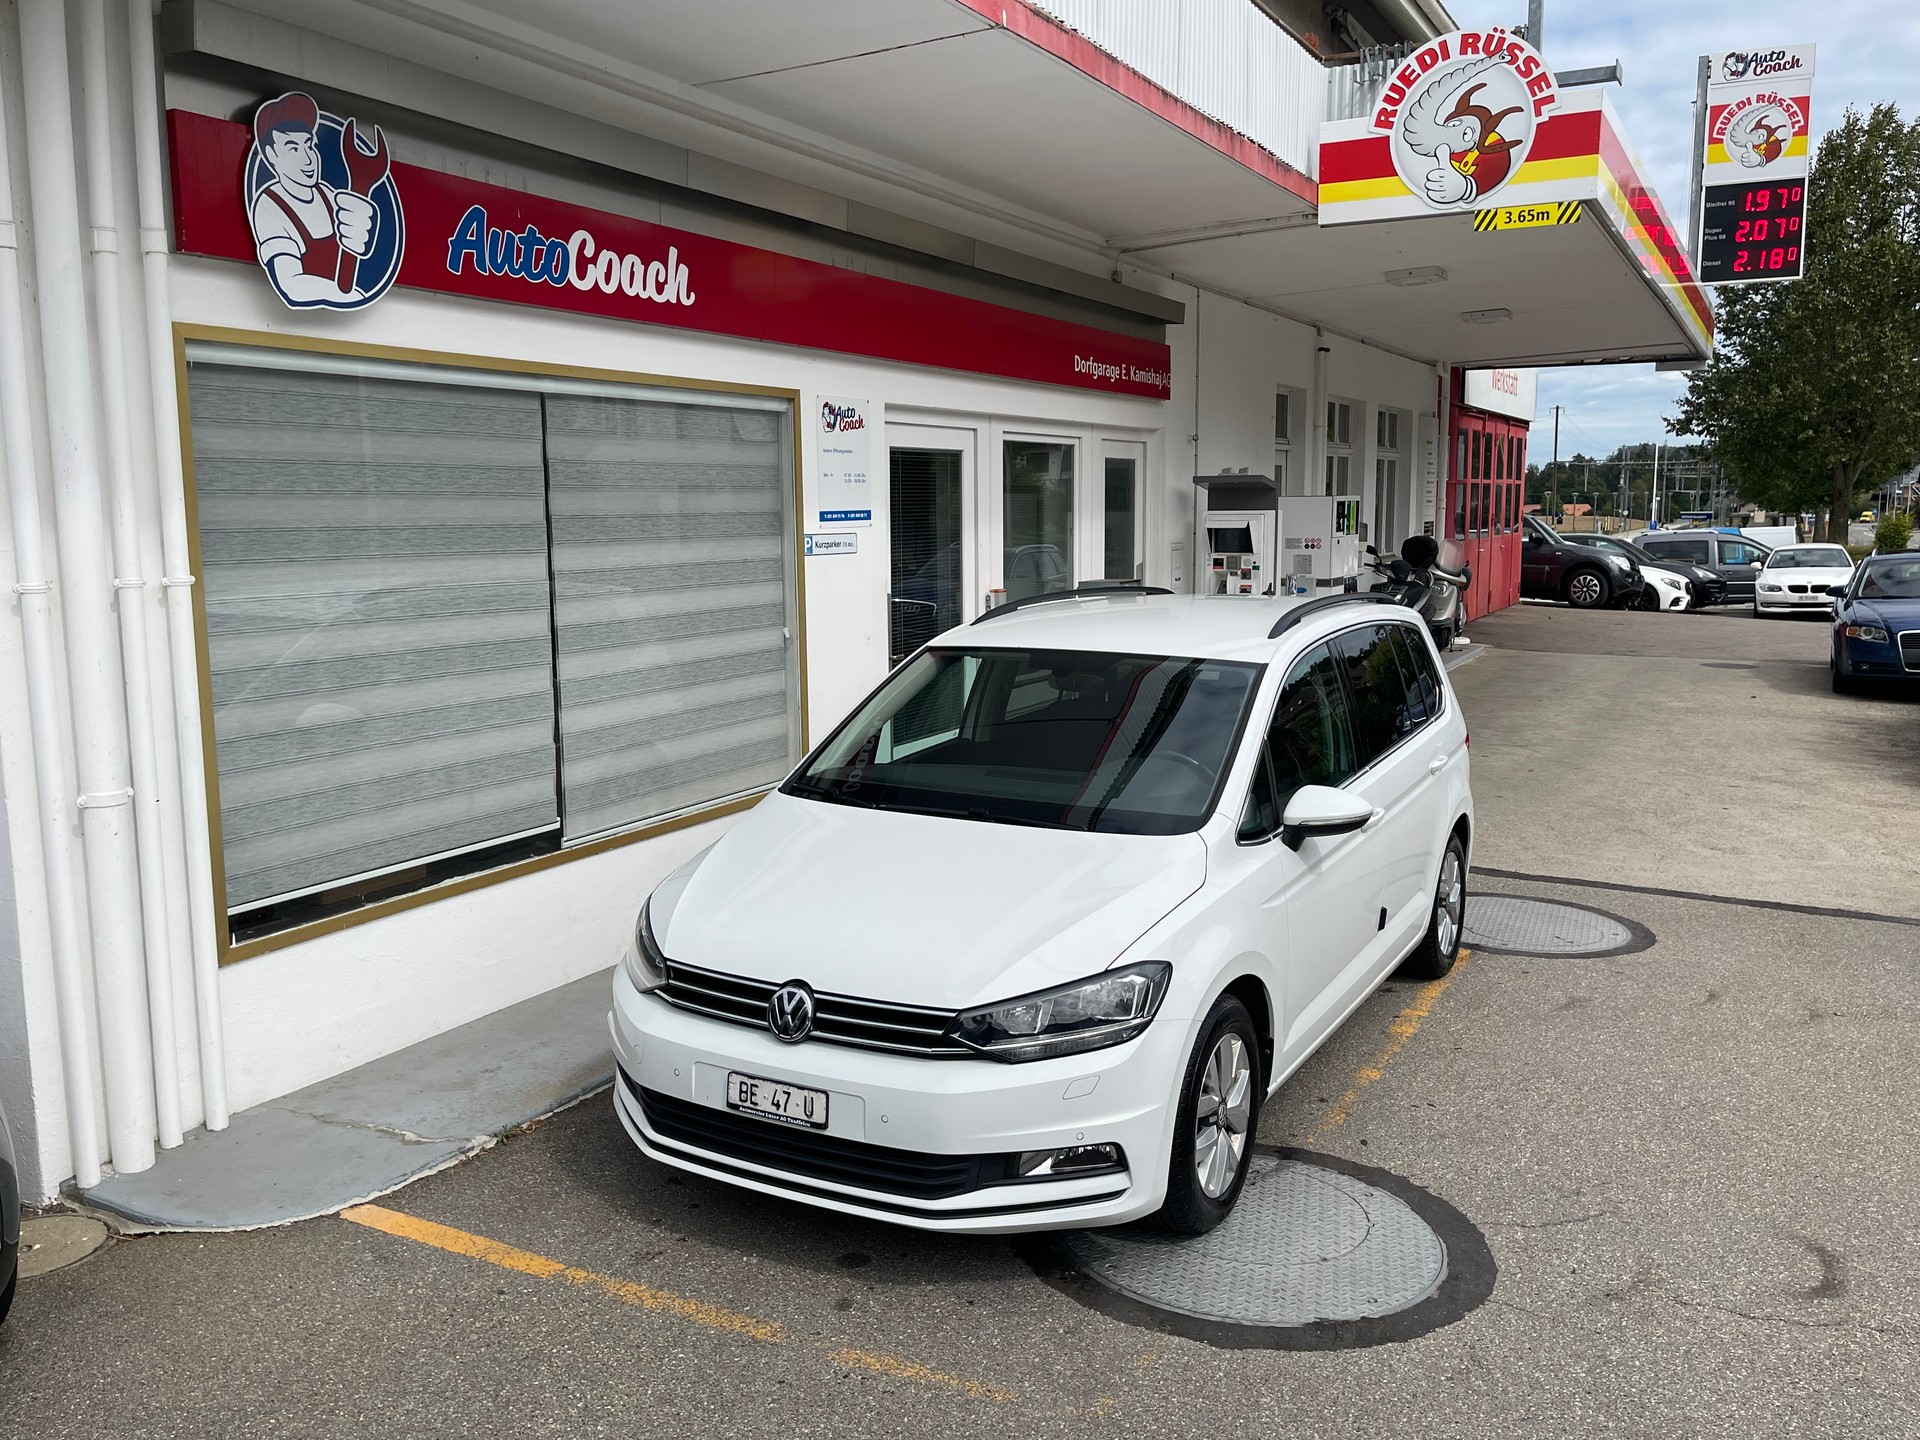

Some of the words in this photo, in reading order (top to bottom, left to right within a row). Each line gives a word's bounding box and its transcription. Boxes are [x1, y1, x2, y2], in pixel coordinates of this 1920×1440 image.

[1748, 50, 1785, 68] Auto
[1753, 54, 1803, 77] Coach
[1374, 39, 1450, 130] RUEDI
[1459, 27, 1556, 118] RÜSSEL
[1715, 97, 1752, 136] RUEDI
[1756, 91, 1802, 130] RÜSSEL
[1504, 209, 1550, 224] 3.65m
[1074, 355, 1120, 382] Dorfgarage
[1121, 364, 1128, 380] E.
[1130, 365, 1162, 390] Kamishaj
[836, 405, 856, 421] Auto
[839, 414, 865, 432] Coach
[805, 537, 812, 554] P
[815, 540, 842, 550] Kurzparker
[738, 1080, 759, 1106] BE
[771, 1088, 792, 1113] 47
[803, 1095, 815, 1119] U
